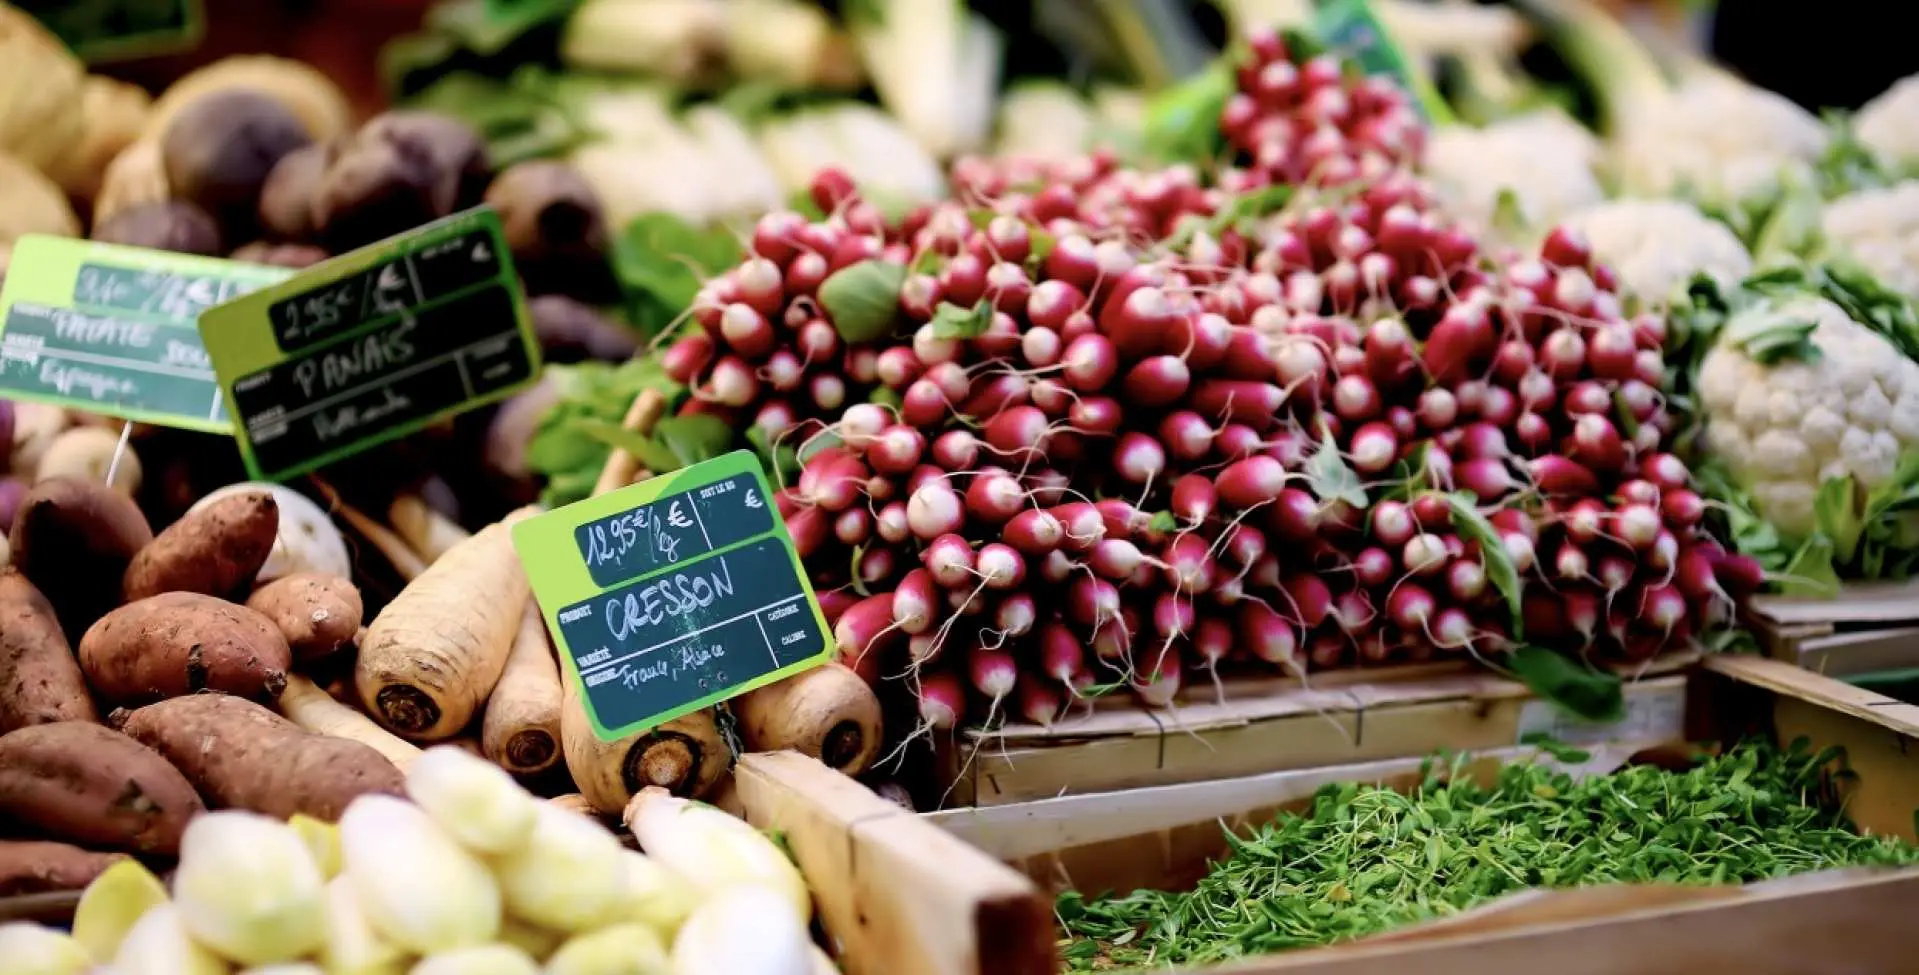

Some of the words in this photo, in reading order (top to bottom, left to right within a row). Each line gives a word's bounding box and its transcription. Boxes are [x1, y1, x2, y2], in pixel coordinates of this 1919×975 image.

[293, 332, 415, 398] PANAIS
[744, 488, 764, 509] €
[606, 556, 734, 641] CRESSON
